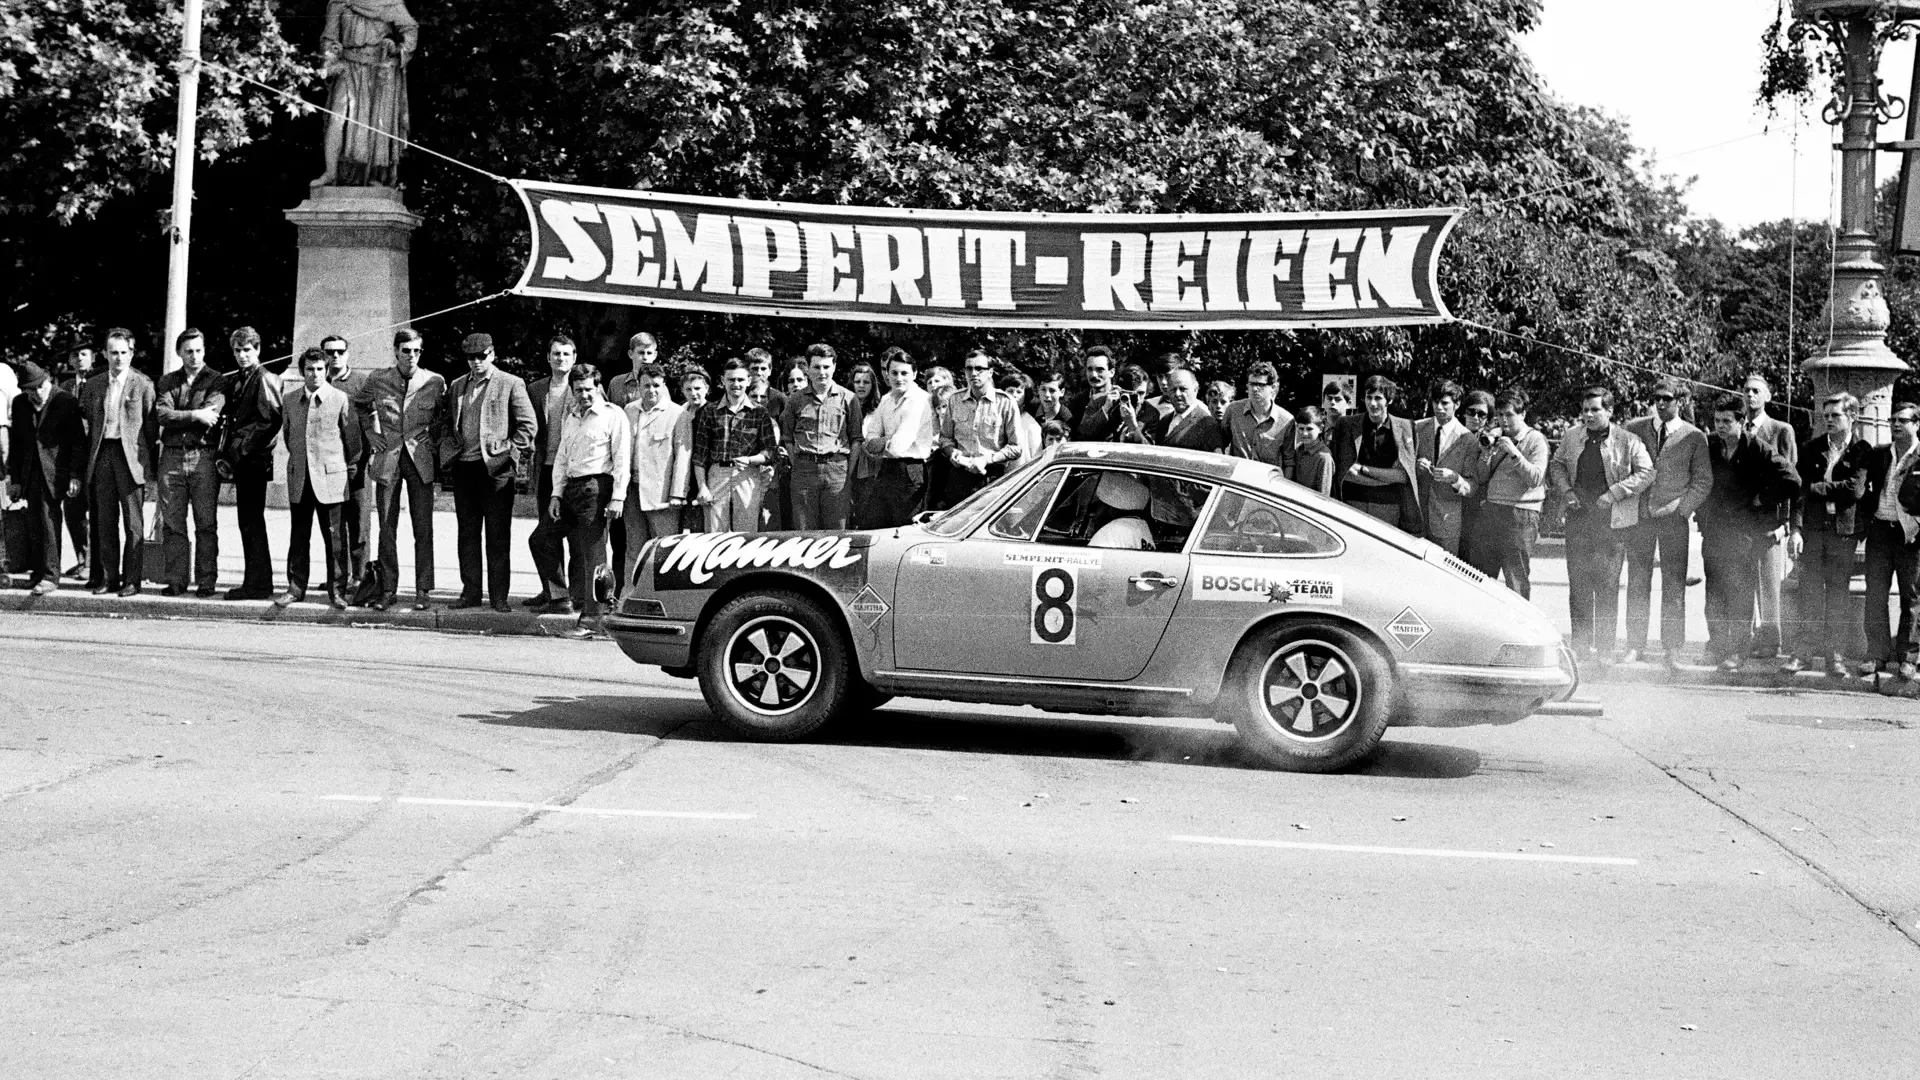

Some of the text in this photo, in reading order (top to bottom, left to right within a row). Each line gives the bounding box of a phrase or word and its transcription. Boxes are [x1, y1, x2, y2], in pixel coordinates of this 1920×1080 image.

[540, 198, 1430, 311] SEMPERIT-REIFEN
[659, 532, 862, 585] Manner
[1005, 553, 1100, 567] SEMPERIT-RALLYE
[1202, 575, 1266, 592] BOSCH
[1294, 584, 1333, 594] TEAM
[1034, 567, 1074, 643] 8
[1392, 625, 1425, 633] MARTHA
